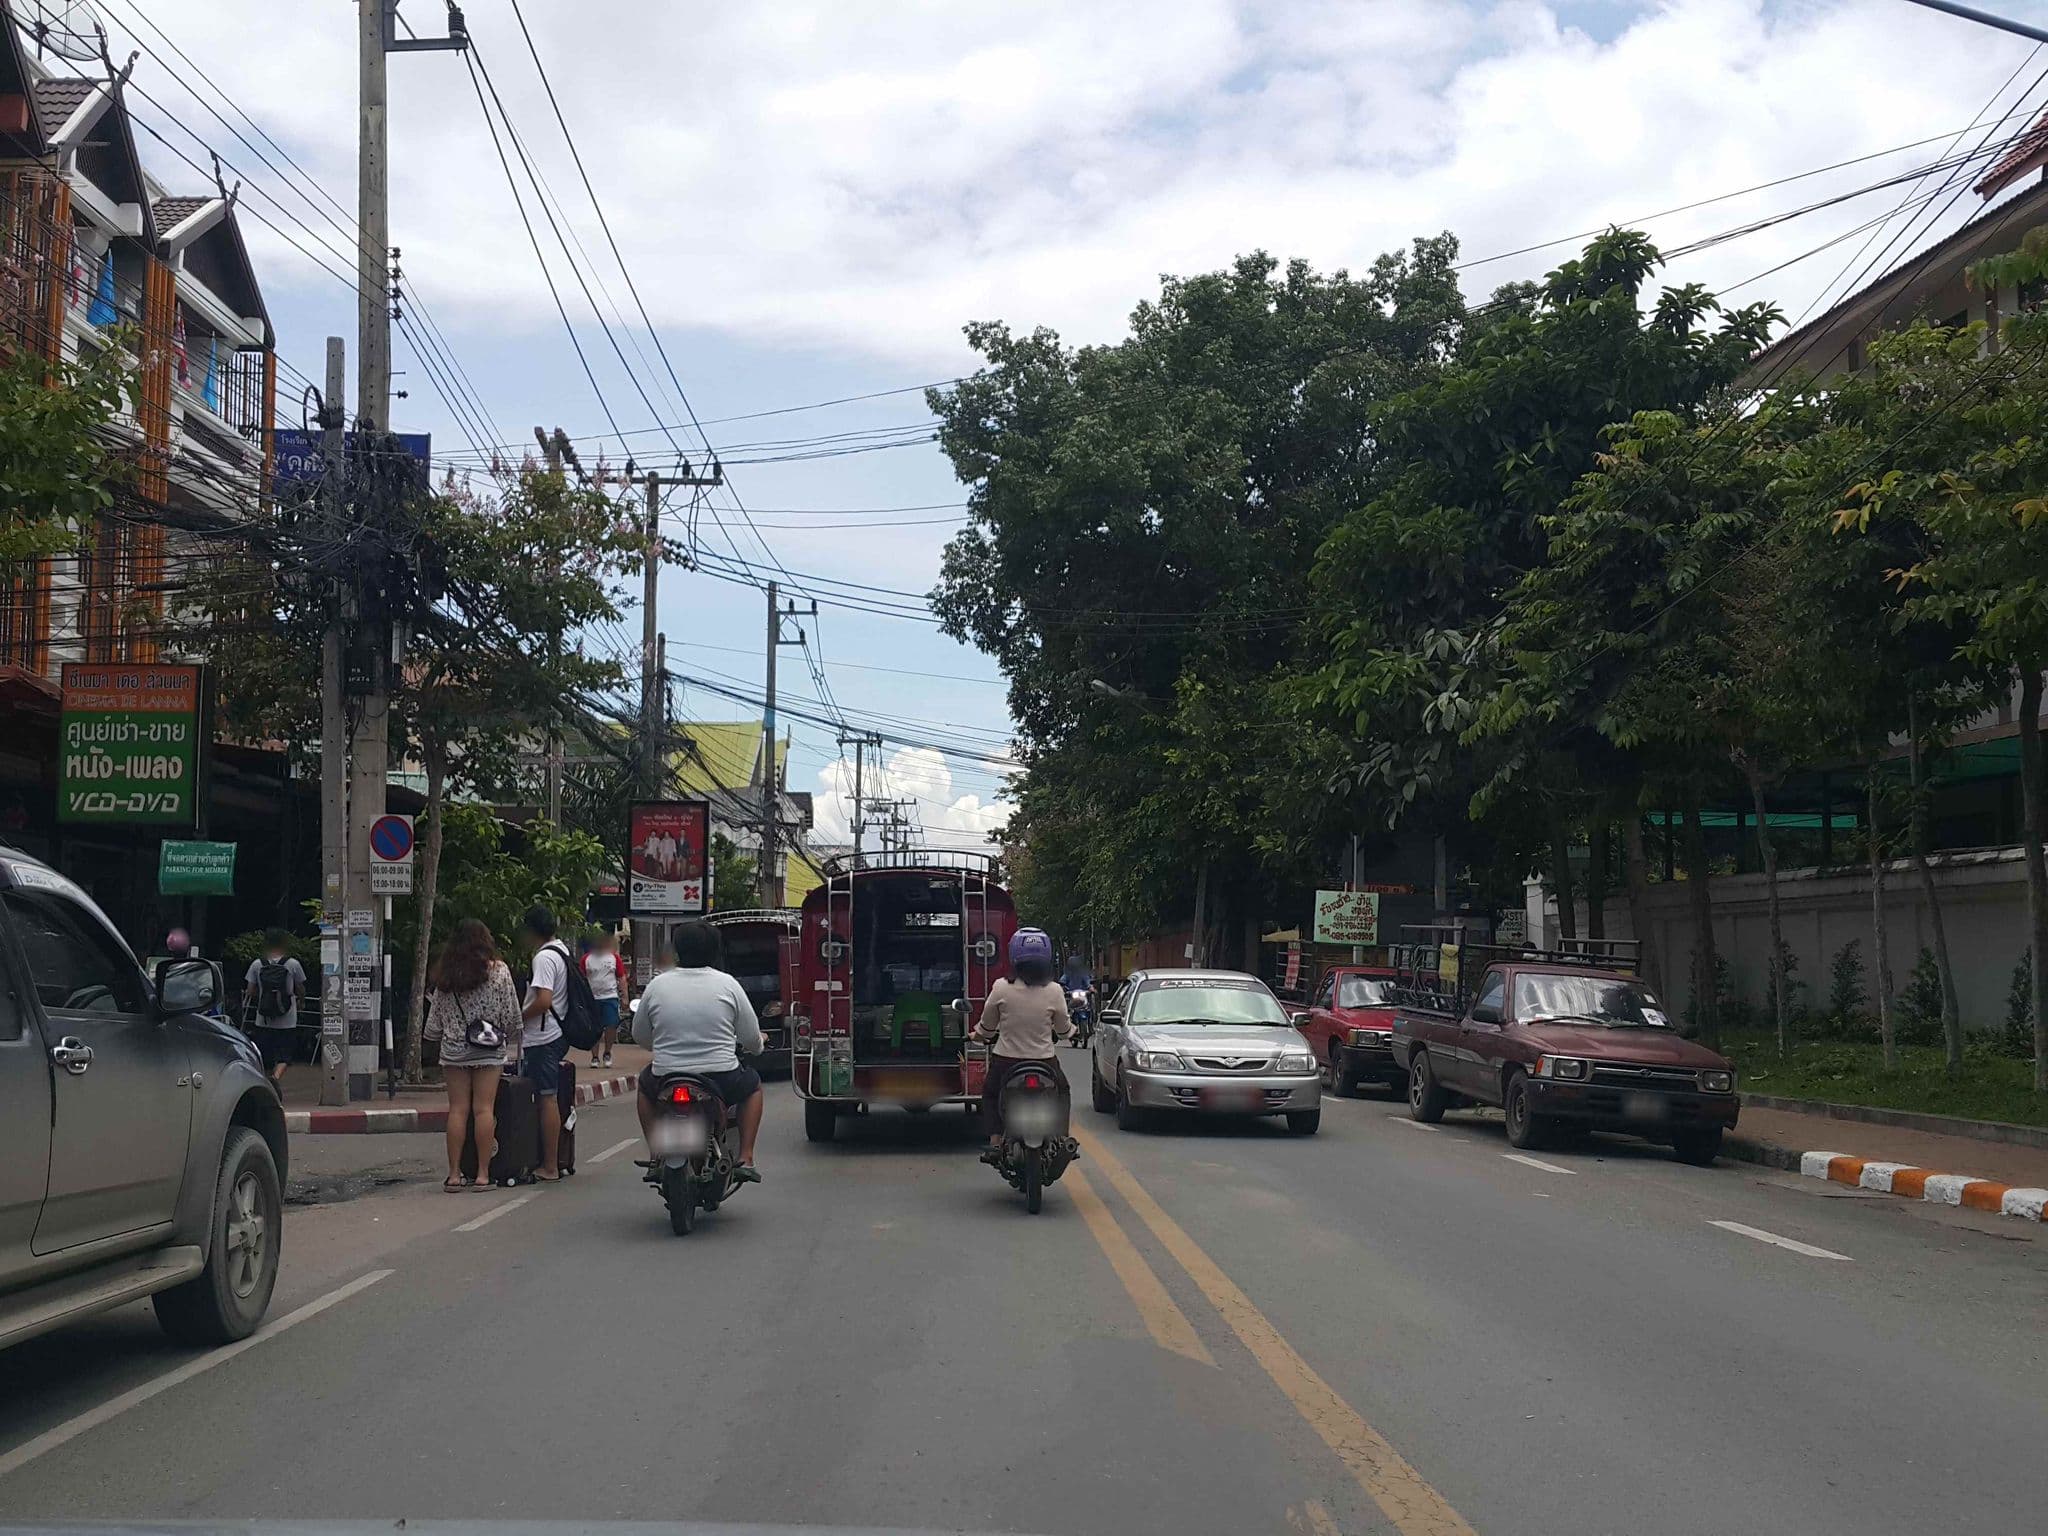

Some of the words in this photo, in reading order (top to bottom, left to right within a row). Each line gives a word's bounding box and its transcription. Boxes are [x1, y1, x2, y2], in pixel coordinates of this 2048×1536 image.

[146, 671, 191, 690] ล้านนา
[121, 694, 137, 708] DE
[140, 694, 188, 708] LANNA
[67, 715, 186, 748] ศูนย์เช่า-ขาย
[66, 745, 183, 779] หนัง-เพลง
[69, 792, 181, 812] VCD-DVD
